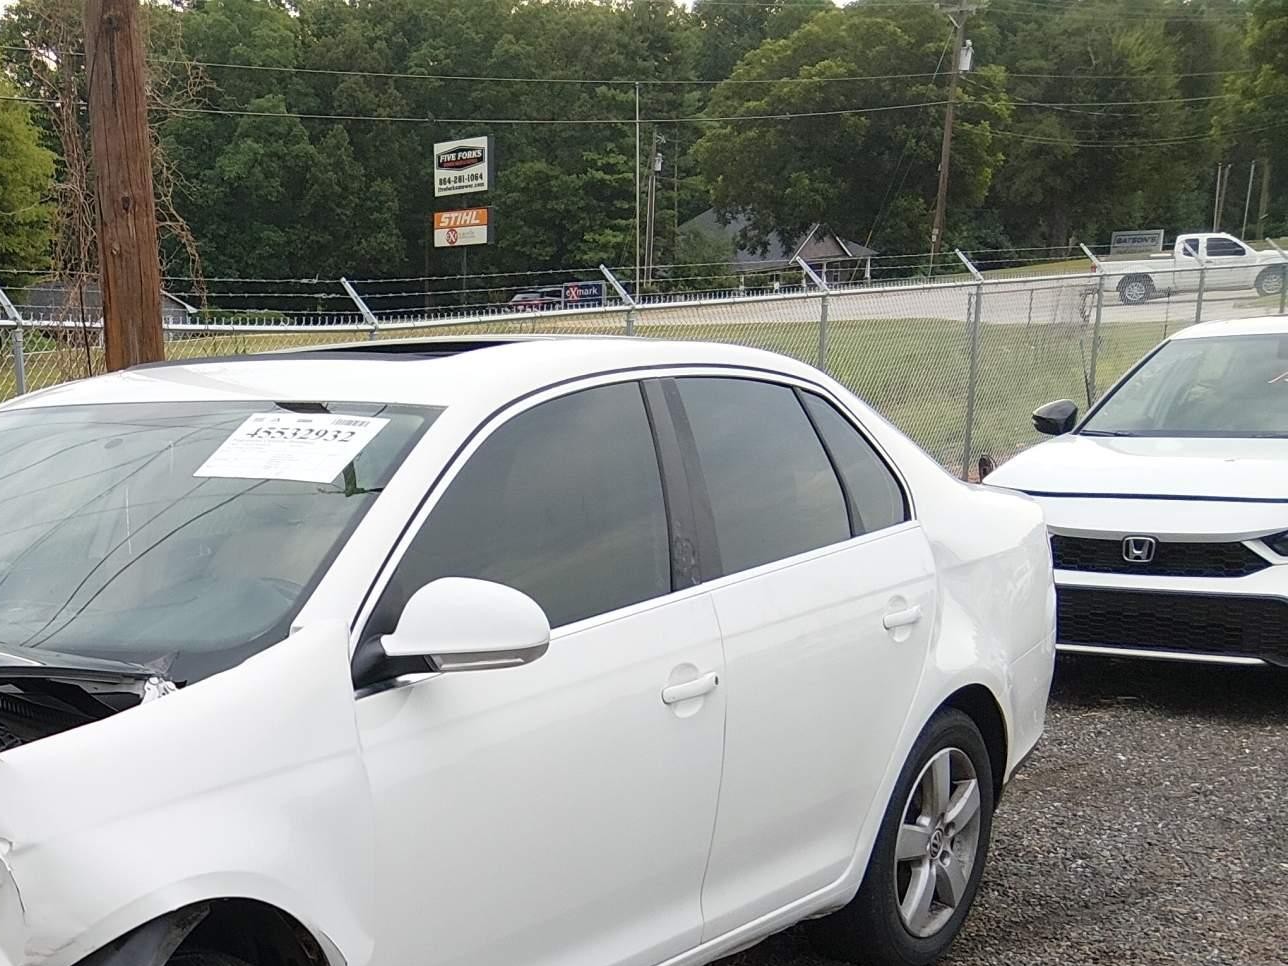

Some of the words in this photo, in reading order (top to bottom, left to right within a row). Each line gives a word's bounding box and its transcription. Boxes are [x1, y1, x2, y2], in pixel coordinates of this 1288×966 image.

[440, 153, 456, 163] FIVE
[457, 150, 482, 160] FORKS
[440, 211, 480, 226] STIHL
[246, 426, 356, 442] 45532932
